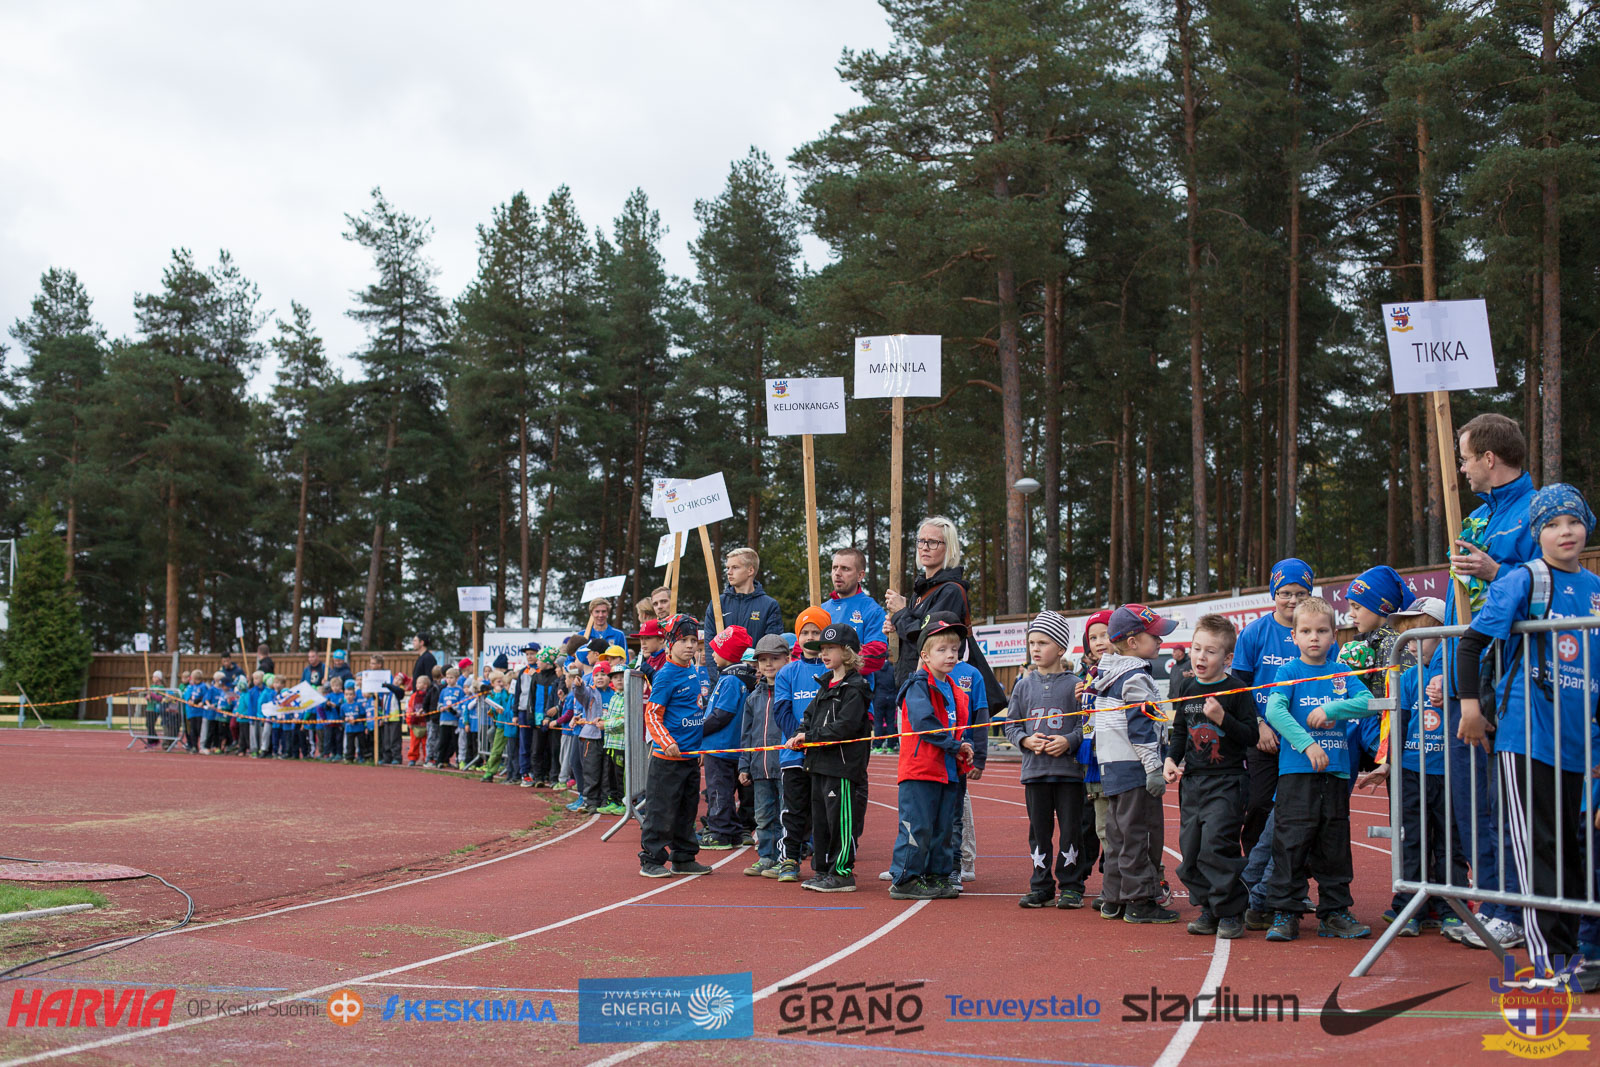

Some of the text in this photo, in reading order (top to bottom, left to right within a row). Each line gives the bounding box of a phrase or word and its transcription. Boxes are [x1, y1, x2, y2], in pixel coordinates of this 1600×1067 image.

[1411, 340, 1469, 363] TIKKA
[869, 362, 926, 374] MANNILA
[773, 401, 840, 411] KELJONKANGAS
[1031, 706, 1064, 731] 78
